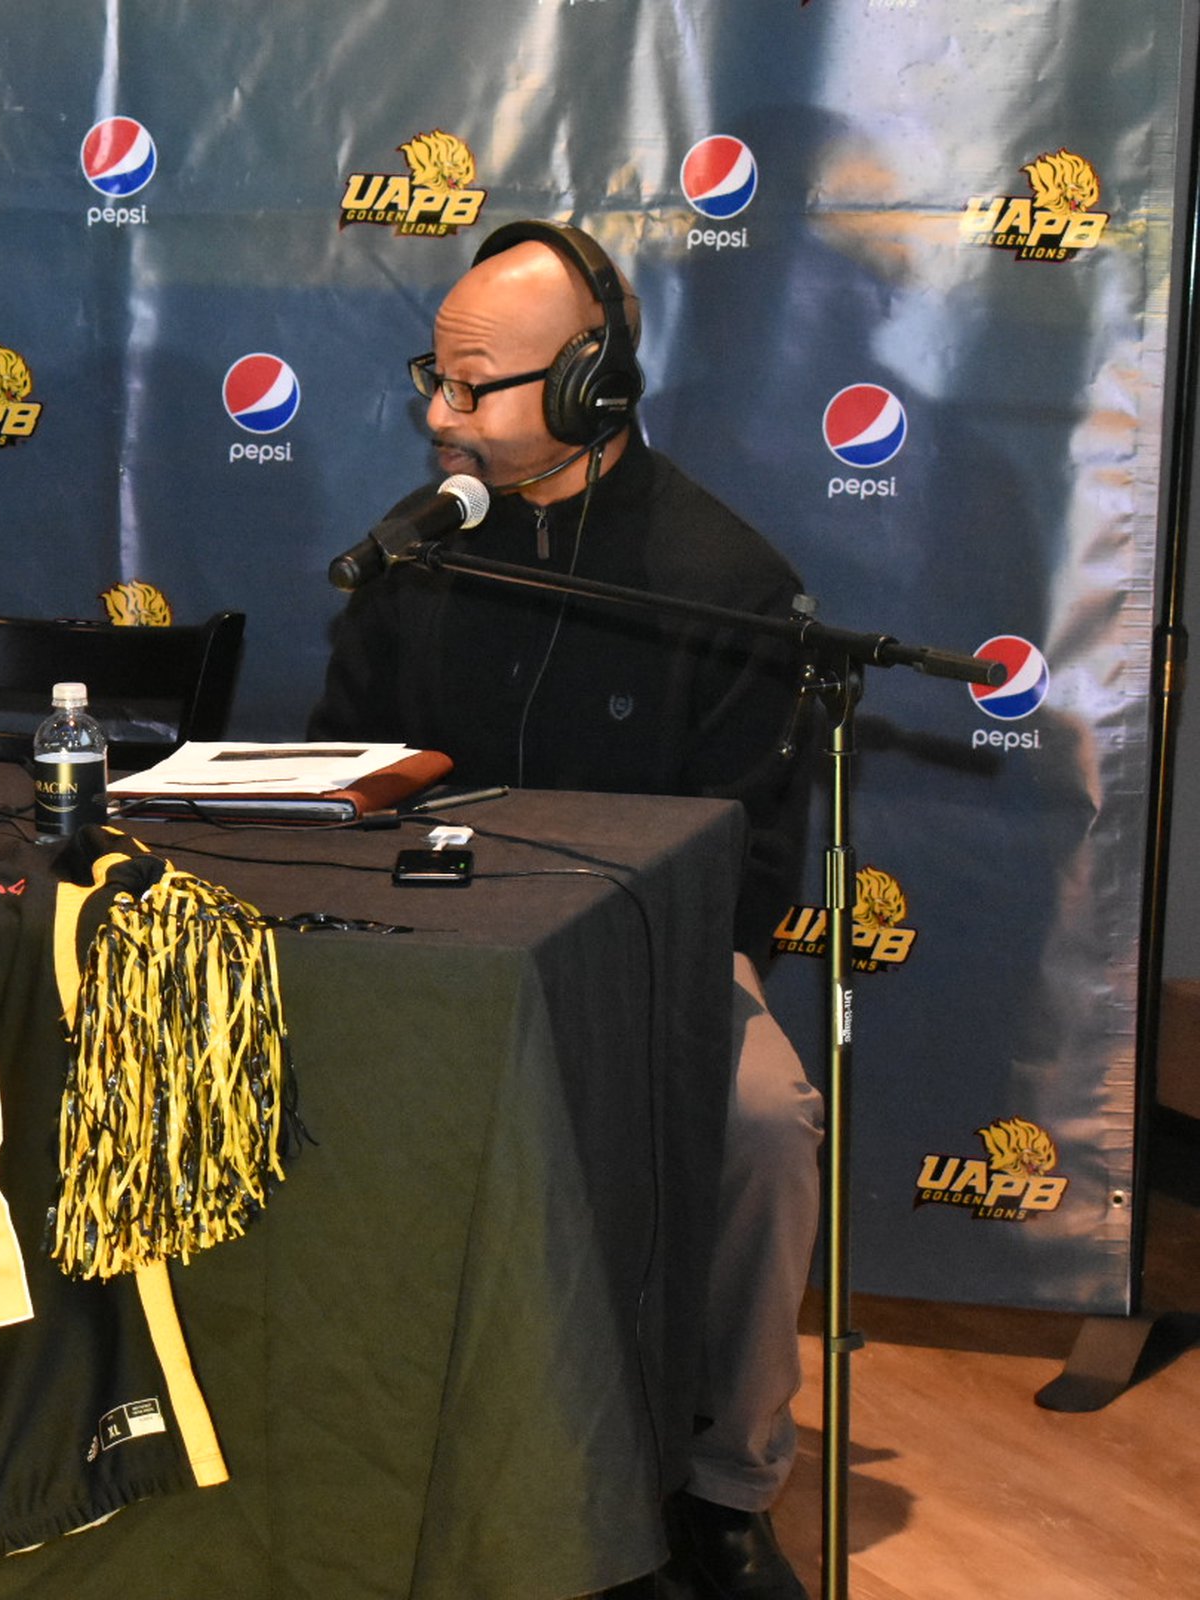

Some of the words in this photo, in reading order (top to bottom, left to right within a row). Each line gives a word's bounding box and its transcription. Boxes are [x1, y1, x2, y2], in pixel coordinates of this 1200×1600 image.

[341, 175, 485, 224] UAPB
[87, 204, 146, 228] pepsi
[346, 209, 406, 222] GOLDEN
[959, 197, 1108, 249] UAPB
[401, 222, 448, 235] LIONS
[687, 227, 748, 252] pepsi
[1021, 247, 1067, 260] LIONS
[229, 441, 292, 464] pepsi
[828, 476, 897, 500] pepsi
[972, 729, 1040, 752] pepsi
[916, 1155, 1069, 1211] UAPB
[922, 1190, 984, 1205] GOLDEN
[978, 1207, 1028, 1220] LIONS
[107, 1423, 122, 1440] XL
